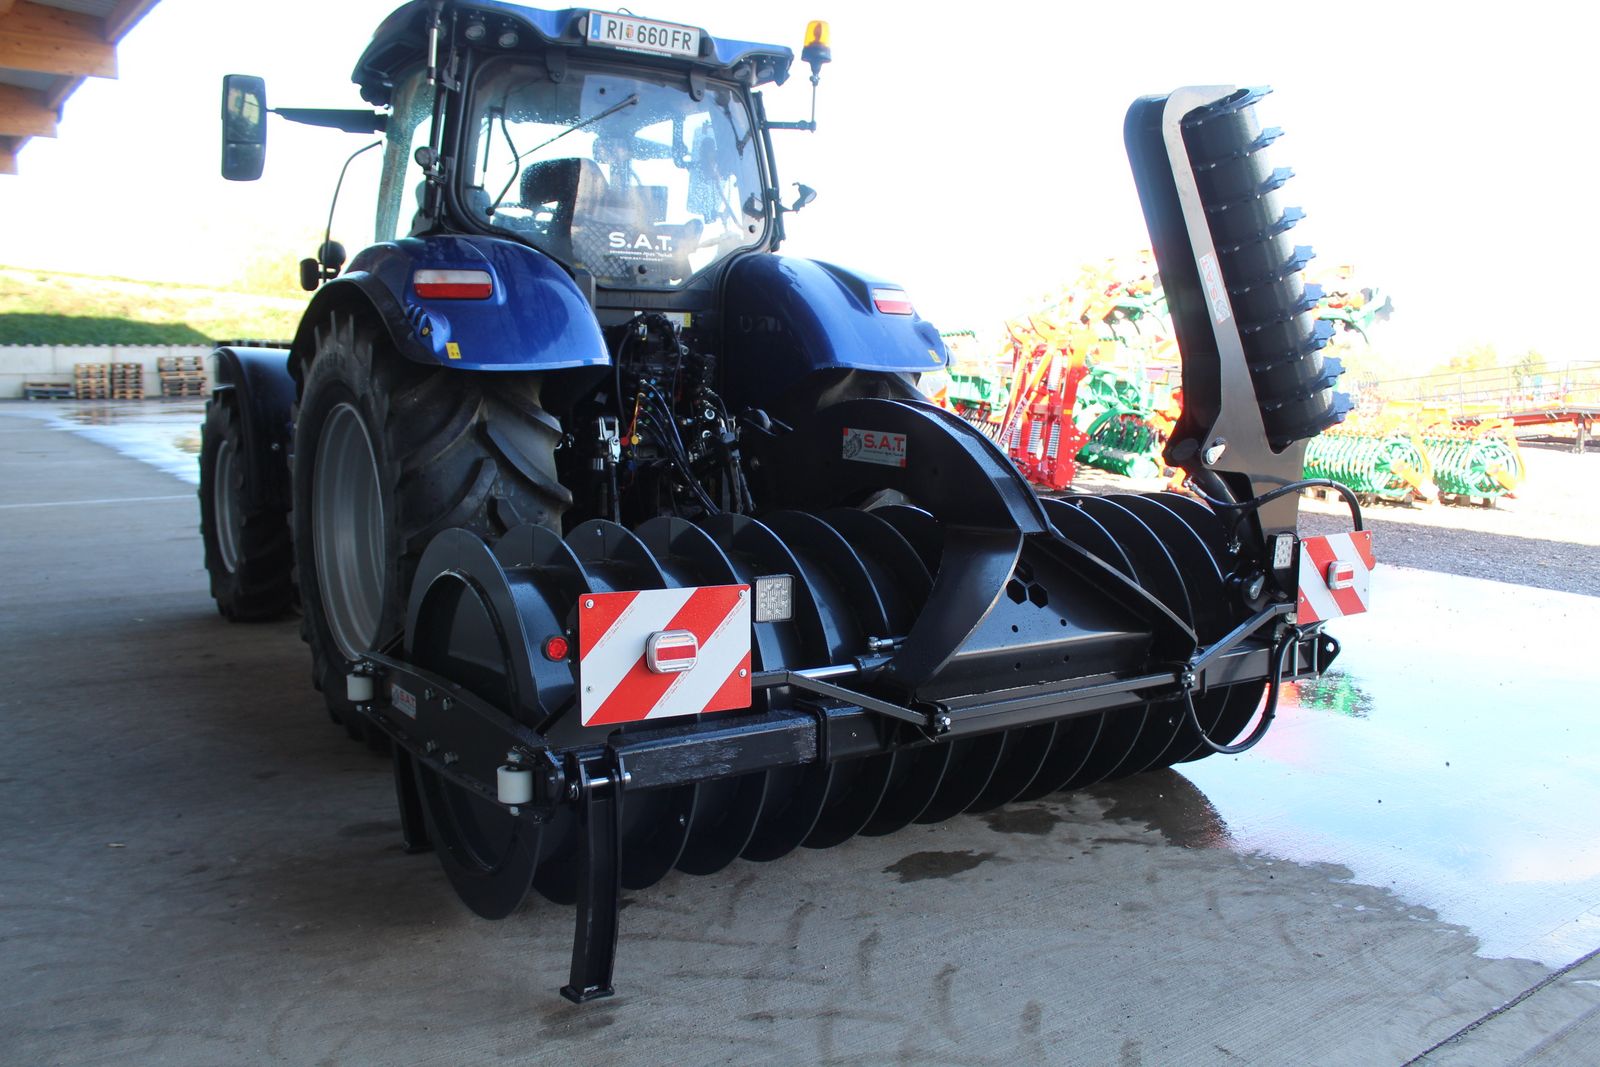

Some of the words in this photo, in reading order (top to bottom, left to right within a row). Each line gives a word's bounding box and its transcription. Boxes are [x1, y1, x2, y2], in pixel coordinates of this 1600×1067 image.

[607, 19, 624, 41] RI
[637, 25, 669, 47] 660
[671, 30, 693, 51] FR
[608, 231, 673, 252] S.A.T.
[863, 432, 906, 452] S.A.T.
